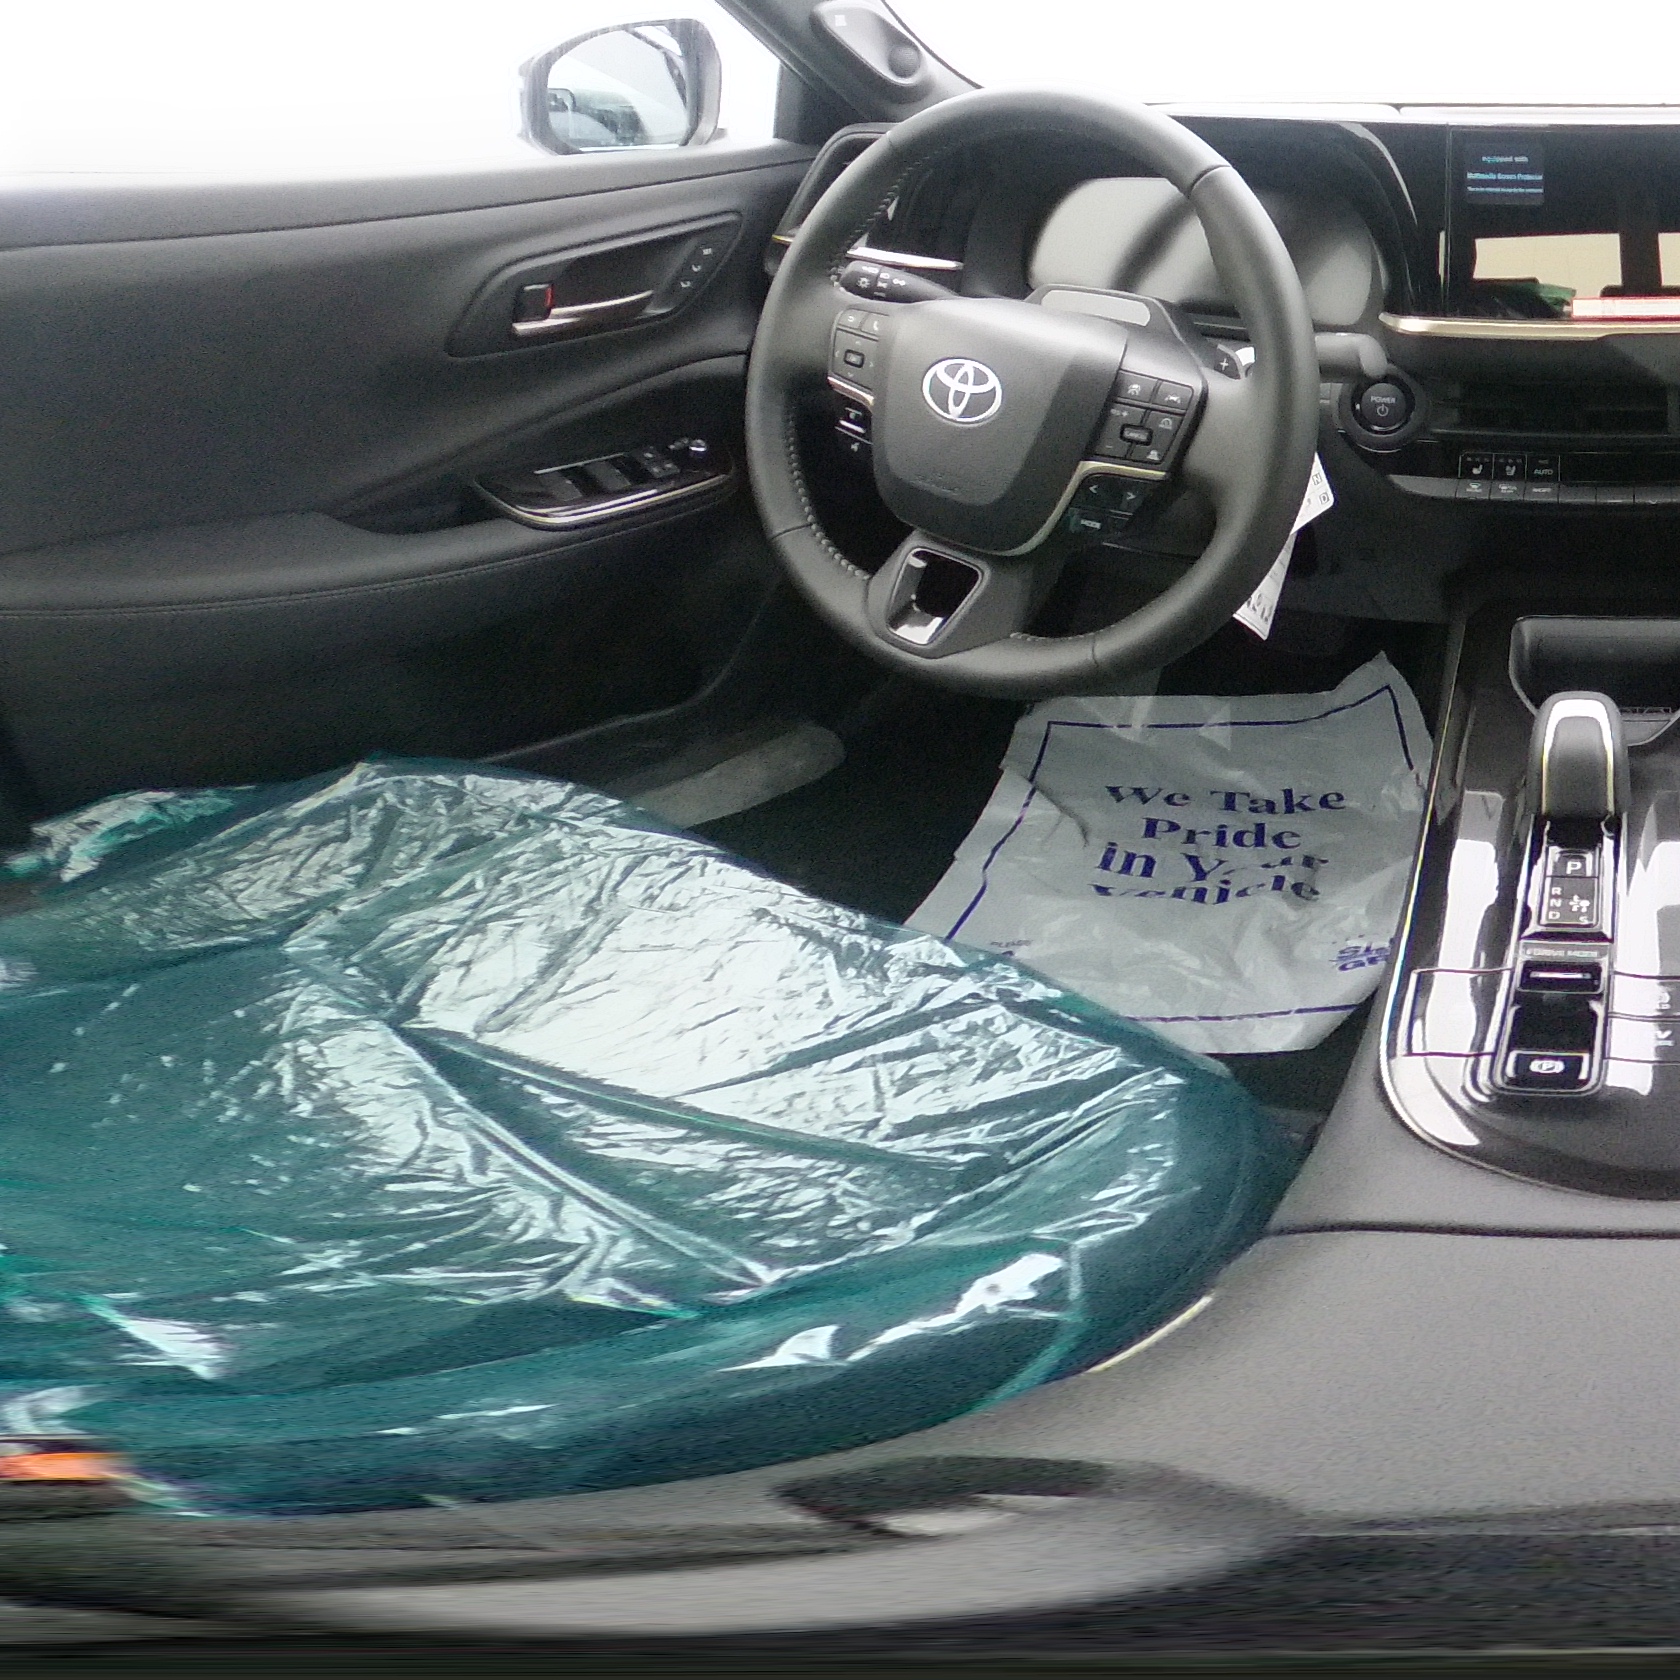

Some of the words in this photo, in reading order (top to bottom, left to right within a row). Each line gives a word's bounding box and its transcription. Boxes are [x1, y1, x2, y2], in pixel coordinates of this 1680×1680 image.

[1371, 395, 1396, 404] POWER
[1534, 468, 1554, 476] AUTO
[1104, 785, 1191, 807] We
[1210, 787, 1347, 815] Take
[1142, 817, 1302, 850] Pride
[1097, 841, 1158, 878] in
[1566, 861, 1582, 875] P
[1551, 887, 1562, 896] R
[1550, 899, 1562, 908] N
[1548, 911, 1561, 920] D
